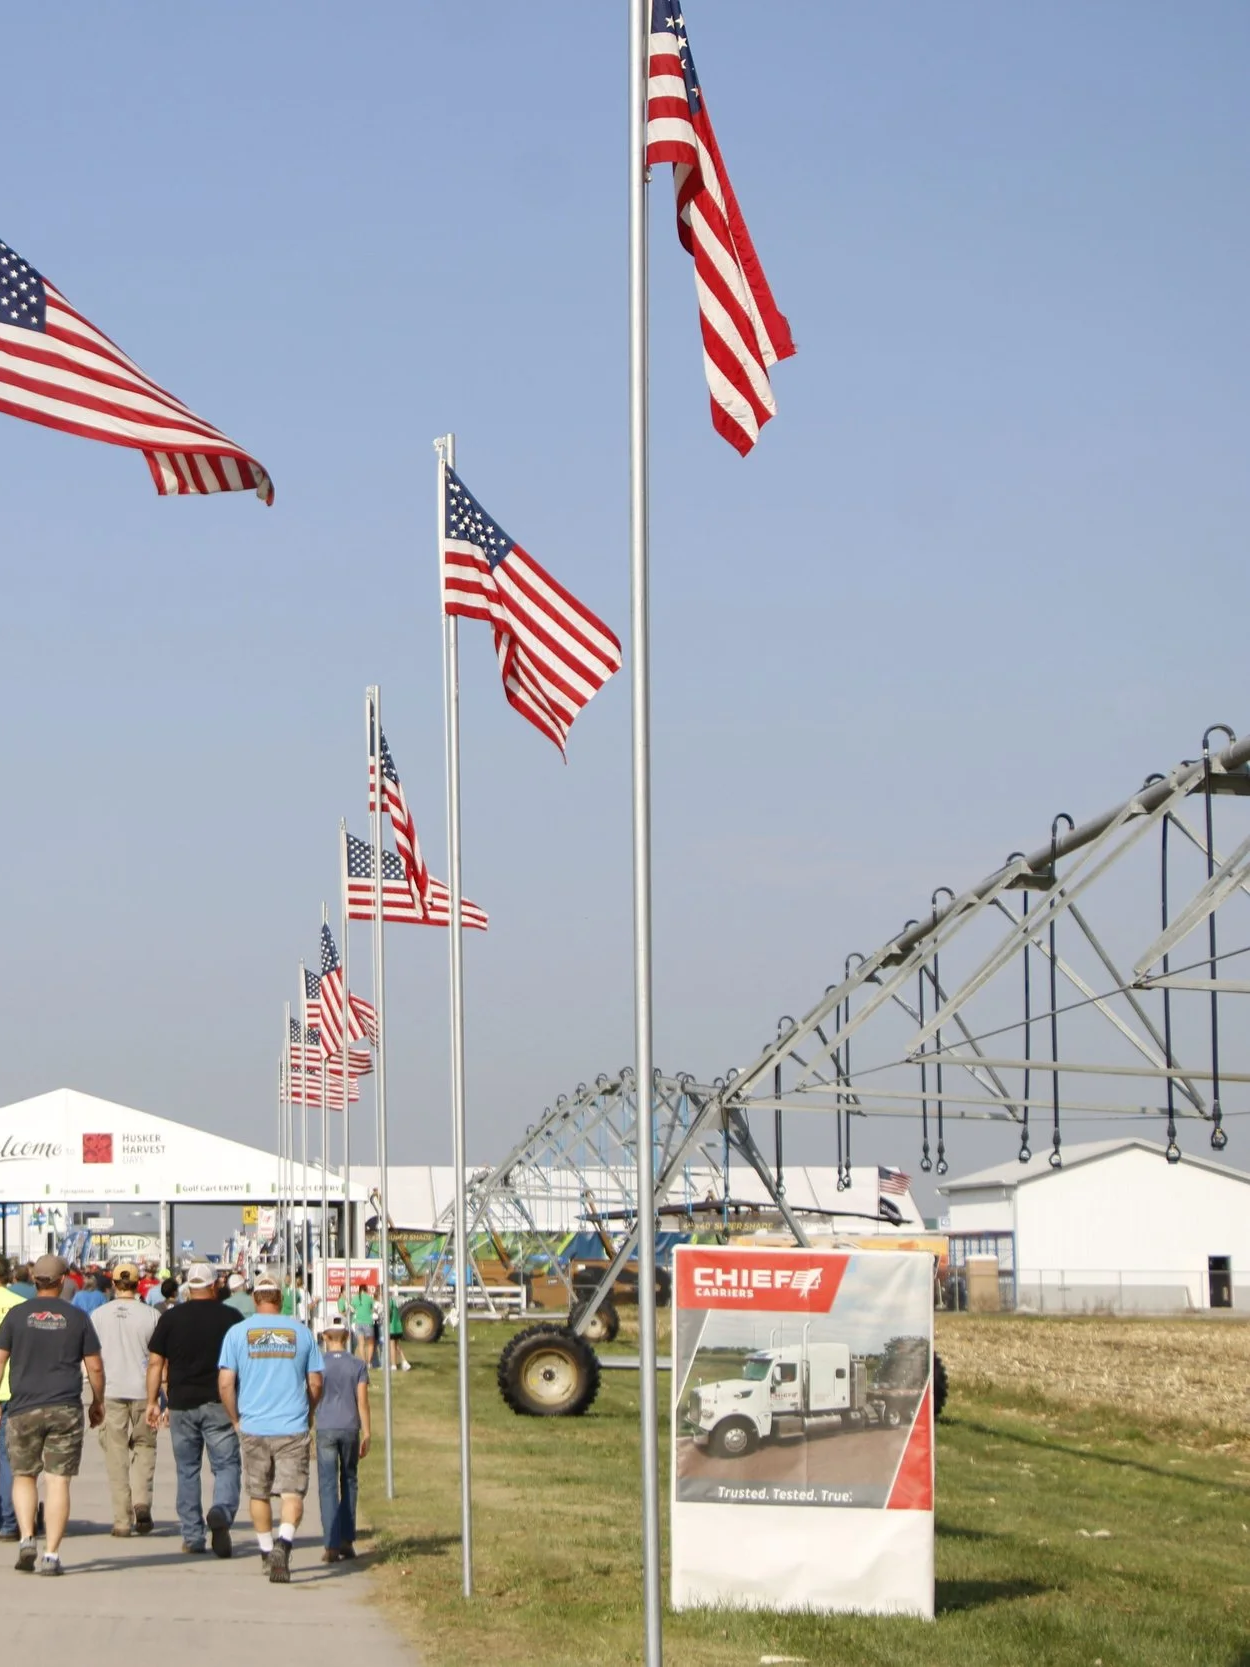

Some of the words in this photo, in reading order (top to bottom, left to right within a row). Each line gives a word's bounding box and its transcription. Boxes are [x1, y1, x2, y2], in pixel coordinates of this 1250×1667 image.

[122, 1133, 161, 1143] HUSKER
[122, 1144, 166, 1154] HARVEST
[122, 1155, 144, 1164] DAYS
[182, 1184, 198, 1192] Golf
[200, 1184, 217, 1192] Cart
[218, 1184, 244, 1192] ENTRY
[329, 1269, 363, 1279] CHEF
[693, 1267, 793, 1289] CHIEF
[695, 1288, 754, 1299] CARRIERS
[718, 1486, 770, 1500] Trusted.
[773, 1488, 818, 1502] Tested.
